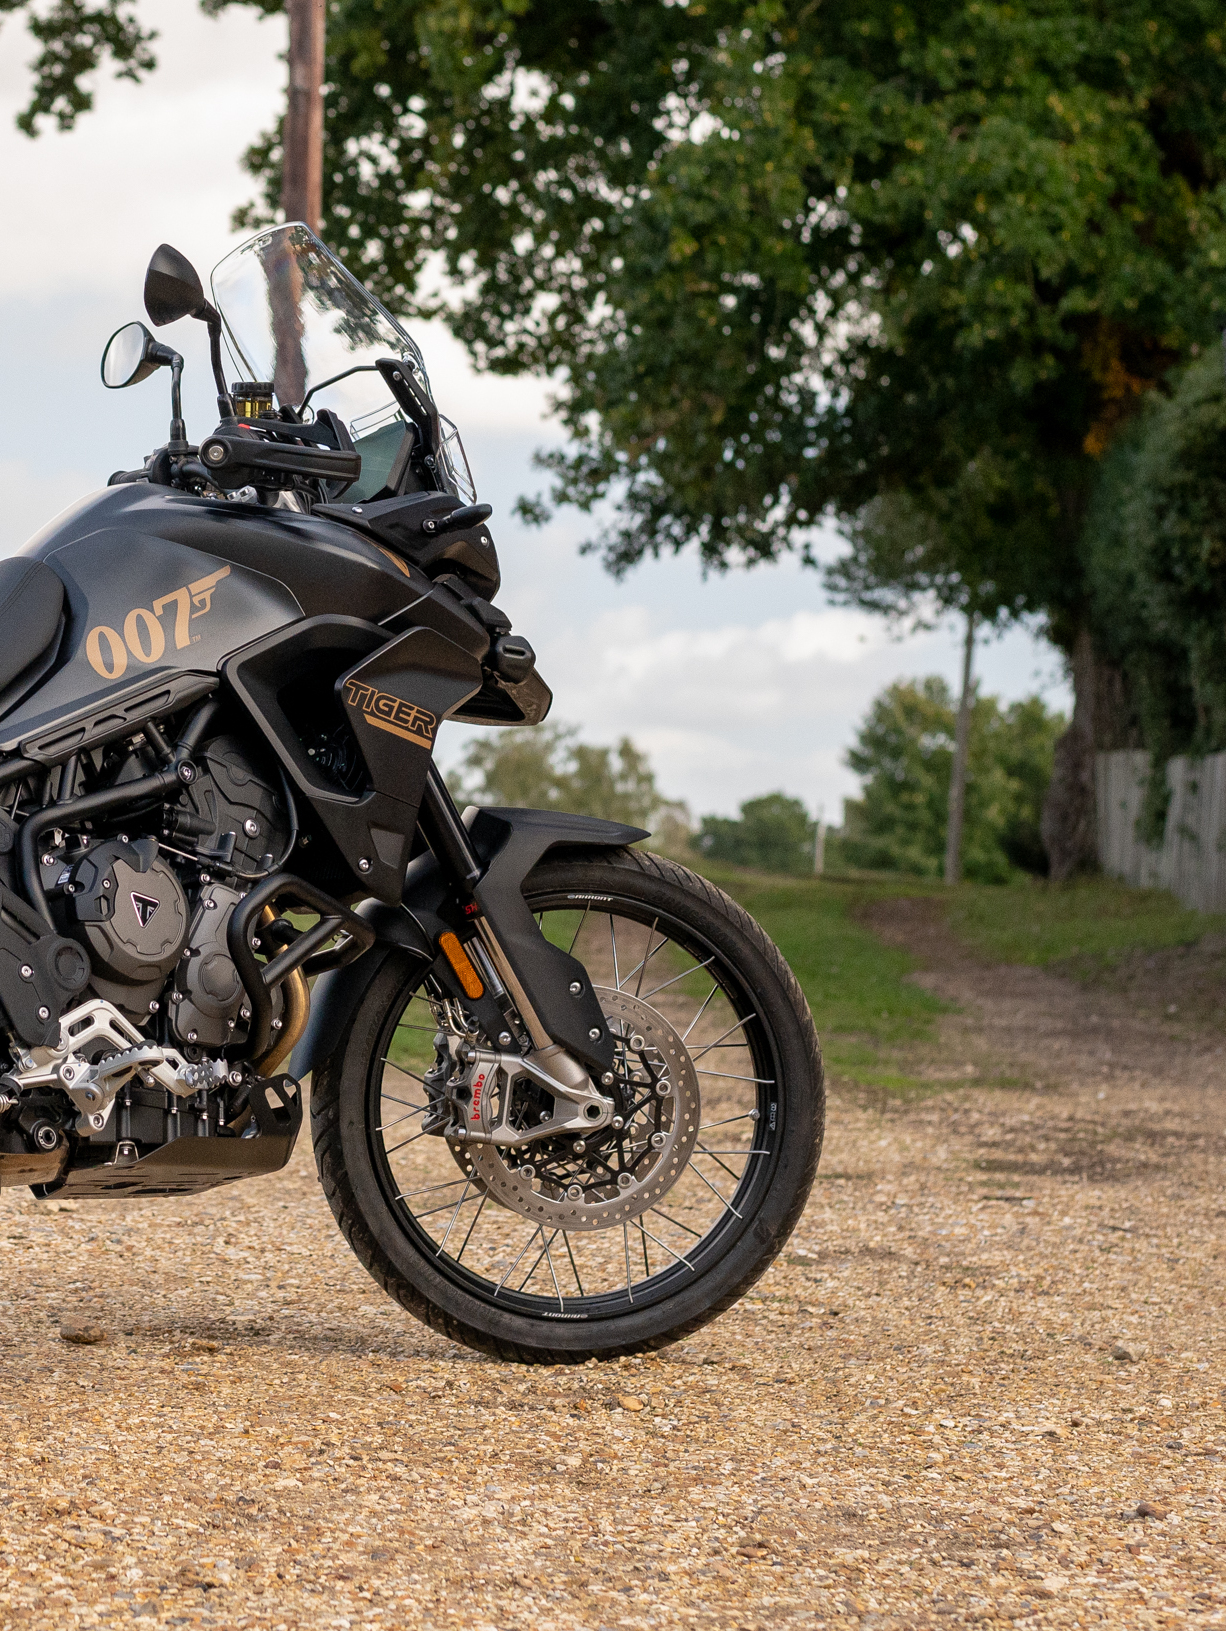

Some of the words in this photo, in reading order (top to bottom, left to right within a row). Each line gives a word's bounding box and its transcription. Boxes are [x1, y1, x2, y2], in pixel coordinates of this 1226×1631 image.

[85, 586, 191, 680] 007
[346, 679, 437, 738] TIGER
[470, 1073, 486, 1121] brembo
